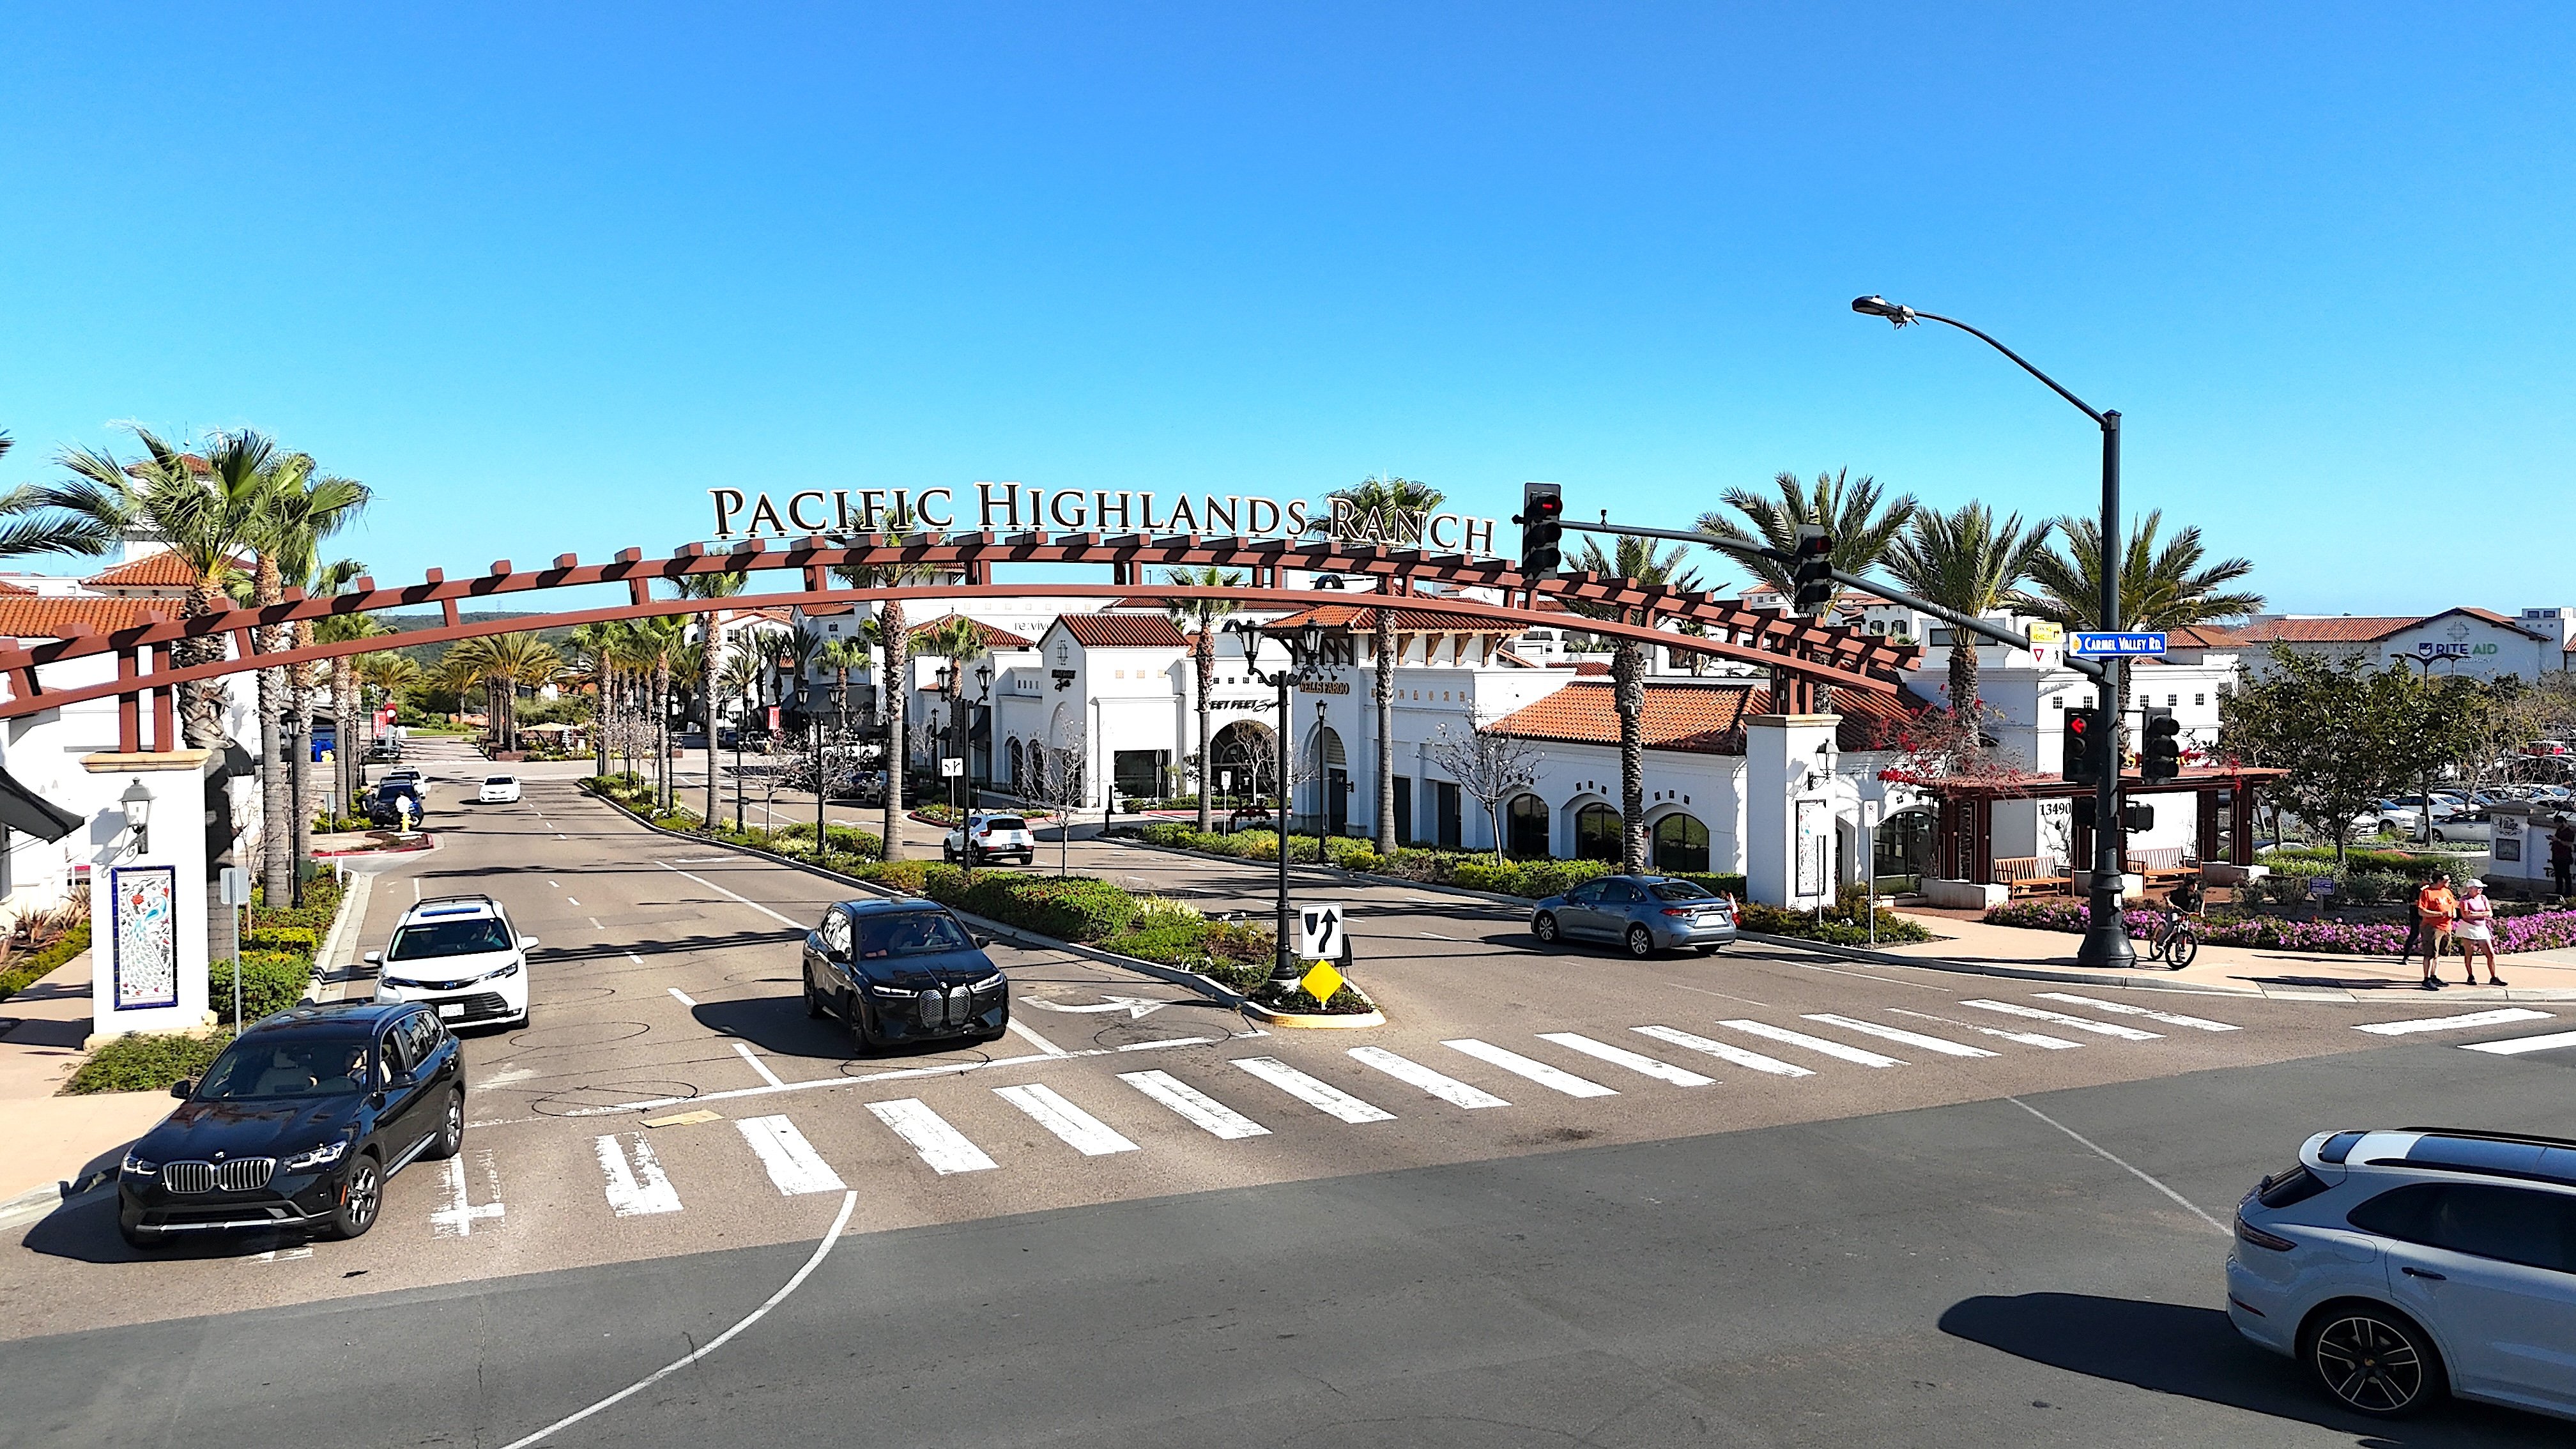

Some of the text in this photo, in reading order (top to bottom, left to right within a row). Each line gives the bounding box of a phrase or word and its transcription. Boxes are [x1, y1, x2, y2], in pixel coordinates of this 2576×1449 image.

[707, 482, 1495, 553] PACIFIC HIGHLANDS RANCH
[2084, 637, 2163, 651] CARMEL VALLEY RD.
[2436, 643, 2497, 654] RITE AID
[1300, 681, 1350, 694] WELLS FARGO
[2039, 802, 2071, 815] 13490
